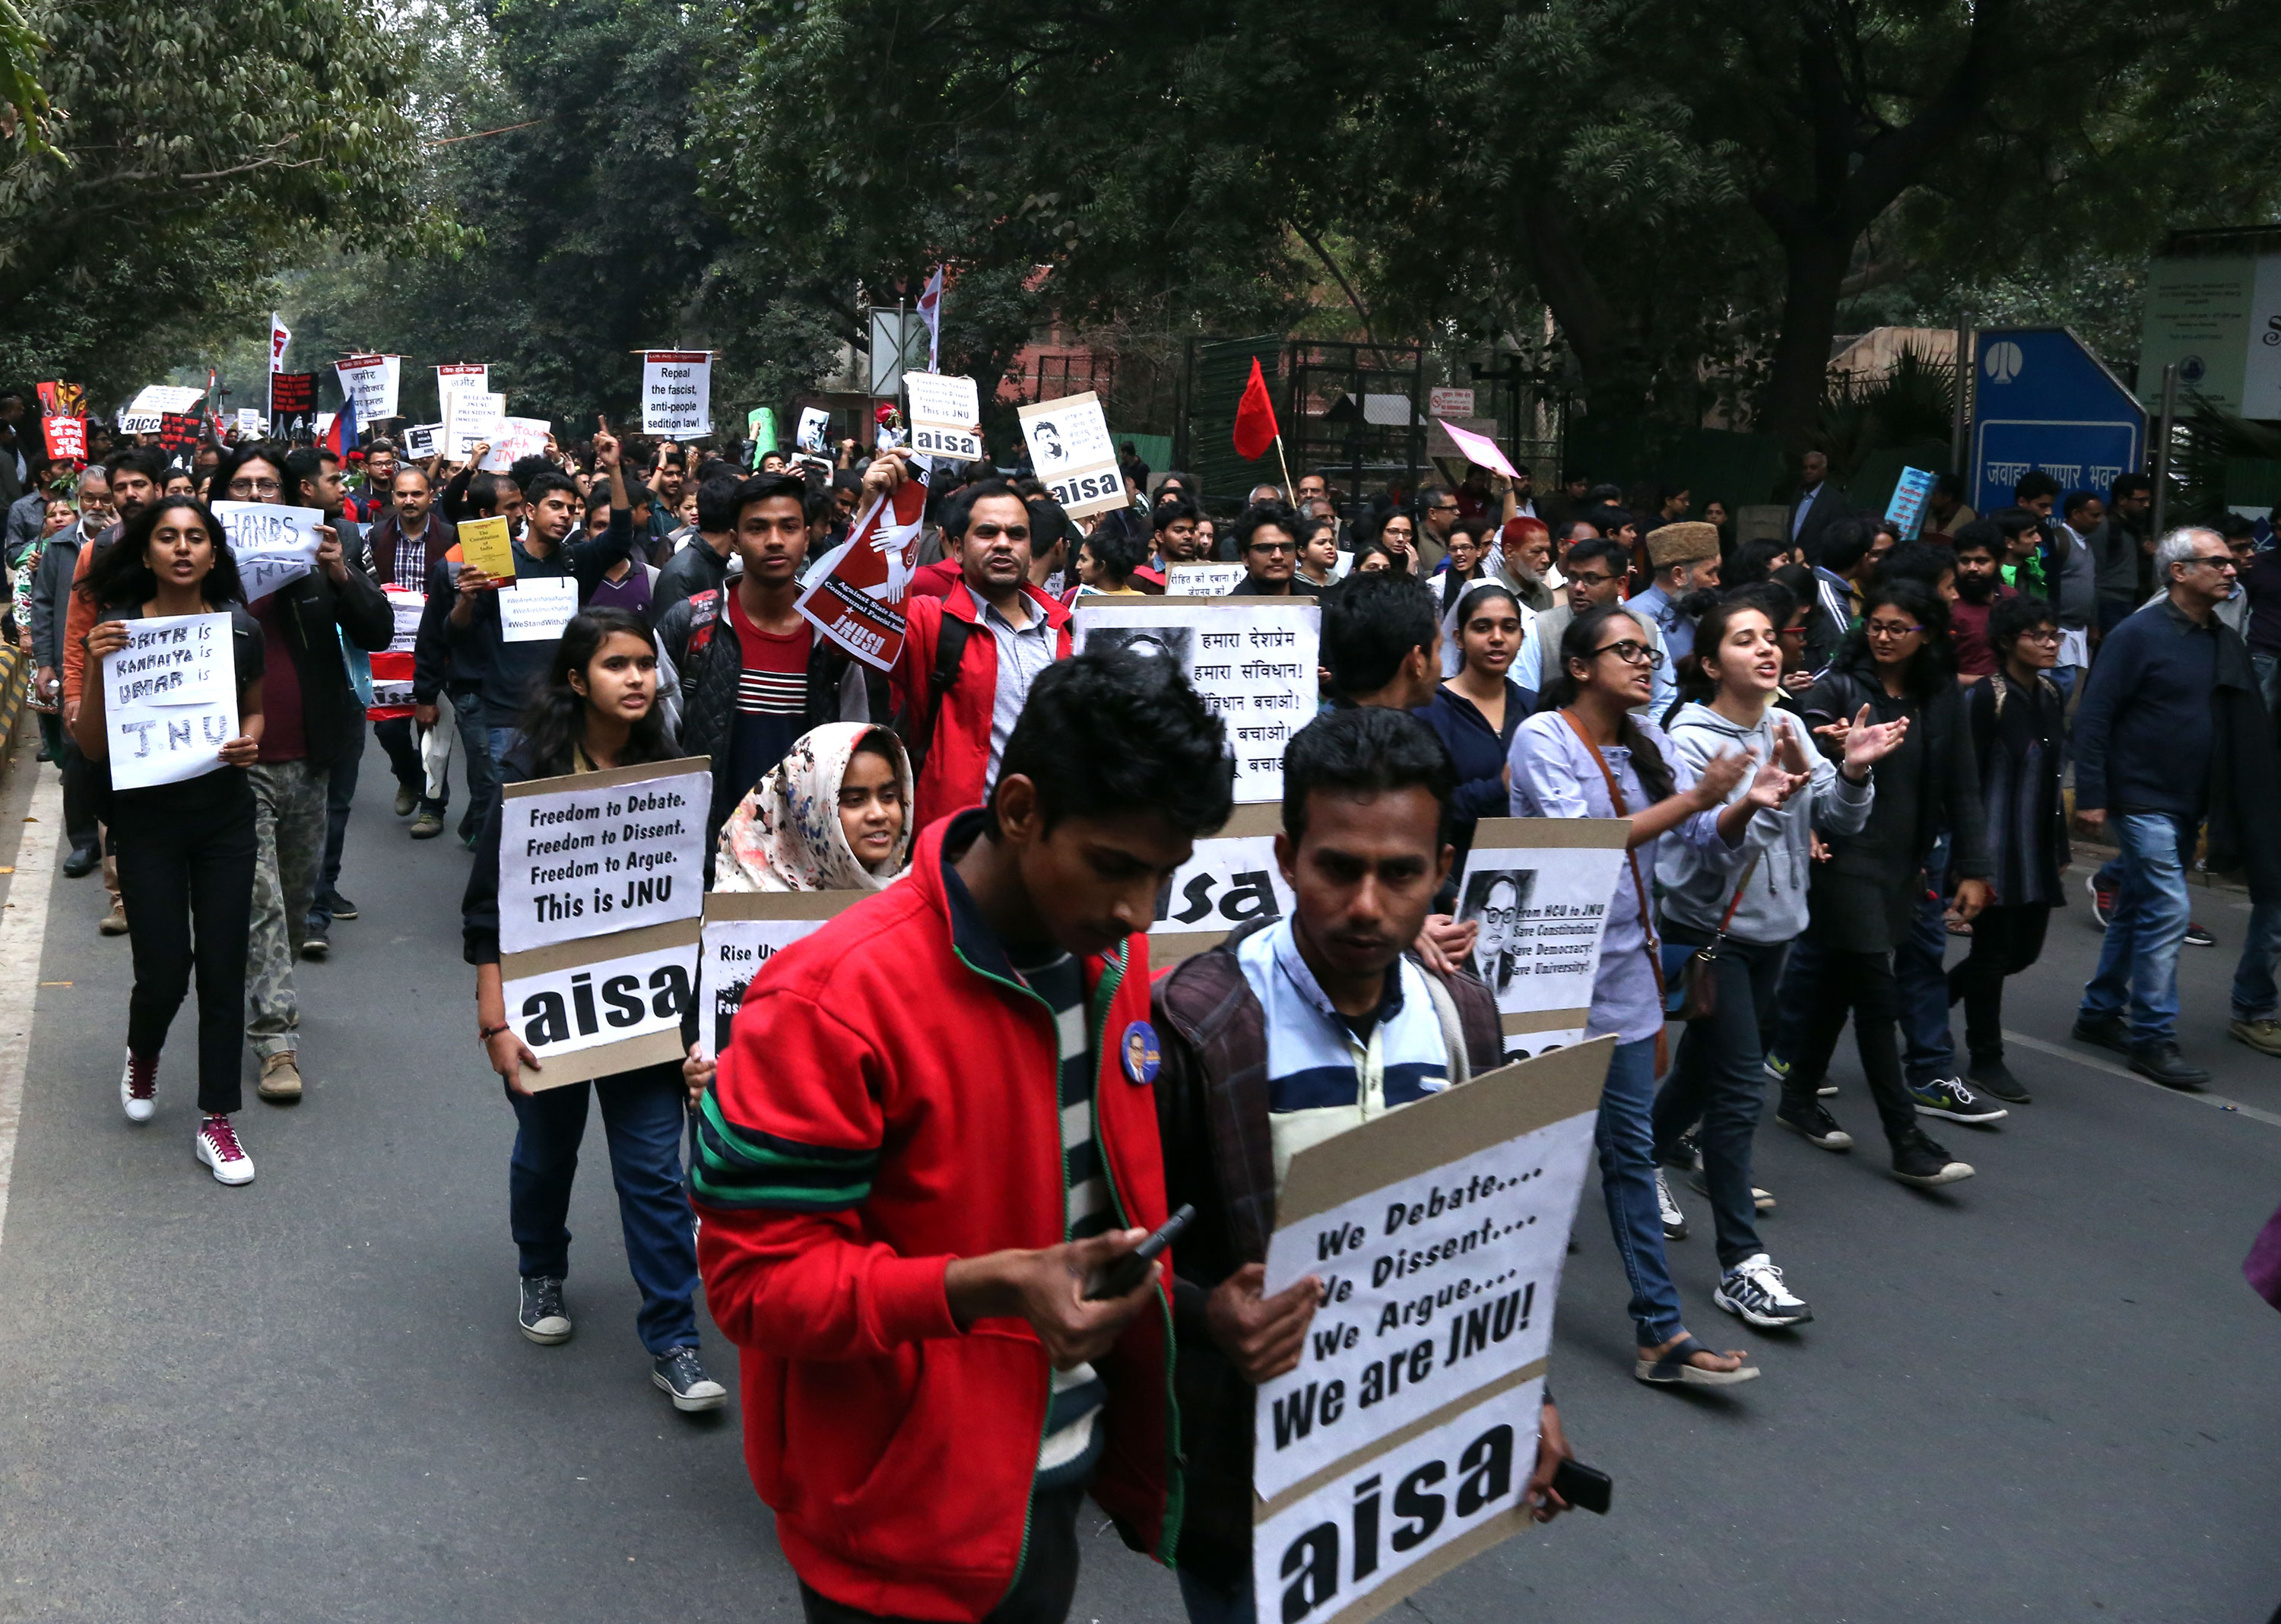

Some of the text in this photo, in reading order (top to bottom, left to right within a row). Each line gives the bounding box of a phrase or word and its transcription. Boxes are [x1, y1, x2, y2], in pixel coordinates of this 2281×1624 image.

[661, 367, 690, 379] Repeal
[652, 384, 697, 395] the fascist,
[365, 398, 383, 407] हमला
[651, 401, 696, 414] anti-people
[923, 405, 969, 419] This is JNU
[514, 421, 548, 437] stand
[648, 418, 700, 429] sedition law!
[502, 436, 529, 449] with
[918, 430, 975, 455] aisa
[494, 449, 531, 463] JN
[1051, 474, 1118, 505] aisa
[220, 513, 300, 548] HANDS
[1171, 573, 1191, 584] रोहित
[1194, 572, 1205, 583] को
[1209, 575, 1229, 583] दबाना
[838, 581, 870, 604] Against
[870, 601, 888, 614] State
[1214, 585, 1225, 595] को
[824, 581, 891, 626] Communal Fascist
[198, 623, 211, 640] is
[508, 618, 571, 628] #WeStandWithJN
[830, 614, 886, 655] JNUSU
[1201, 627, 1296, 649] हमारा देशप्रेम
[116, 645, 213, 678] KANHAIYA is
[1194, 660, 1302, 681] हमारा संविधान!
[119, 669, 210, 704] UMAR is
[1253, 690, 1299, 710] बचाओ!
[1237, 721, 1293, 742] बचाओ!
[530, 792, 686, 827] Freedom to Debate.
[527, 820, 686, 857] Freedom to Dissent.
[531, 852, 677, 885] Freedom to Argue.
[534, 874, 673, 923] This is JNU
[1545, 905, 1567, 917] HCU
[1569, 906, 1580, 917] to
[1581, 904, 1604, 916] JNU
[1513, 922, 1598, 937] Save Constitution!
[721, 945, 751, 961] Rise
[1536, 941, 1594, 956] Democracy!
[1536, 959, 1590, 975] University!
[522, 964, 693, 1047] aisa
[1318, 1221, 1366, 1261] We
[1313, 1321, 1359, 1361] We
[1272, 1282, 1536, 1451] We are JNU!
[1279, 1423, 1514, 1624] aisa
